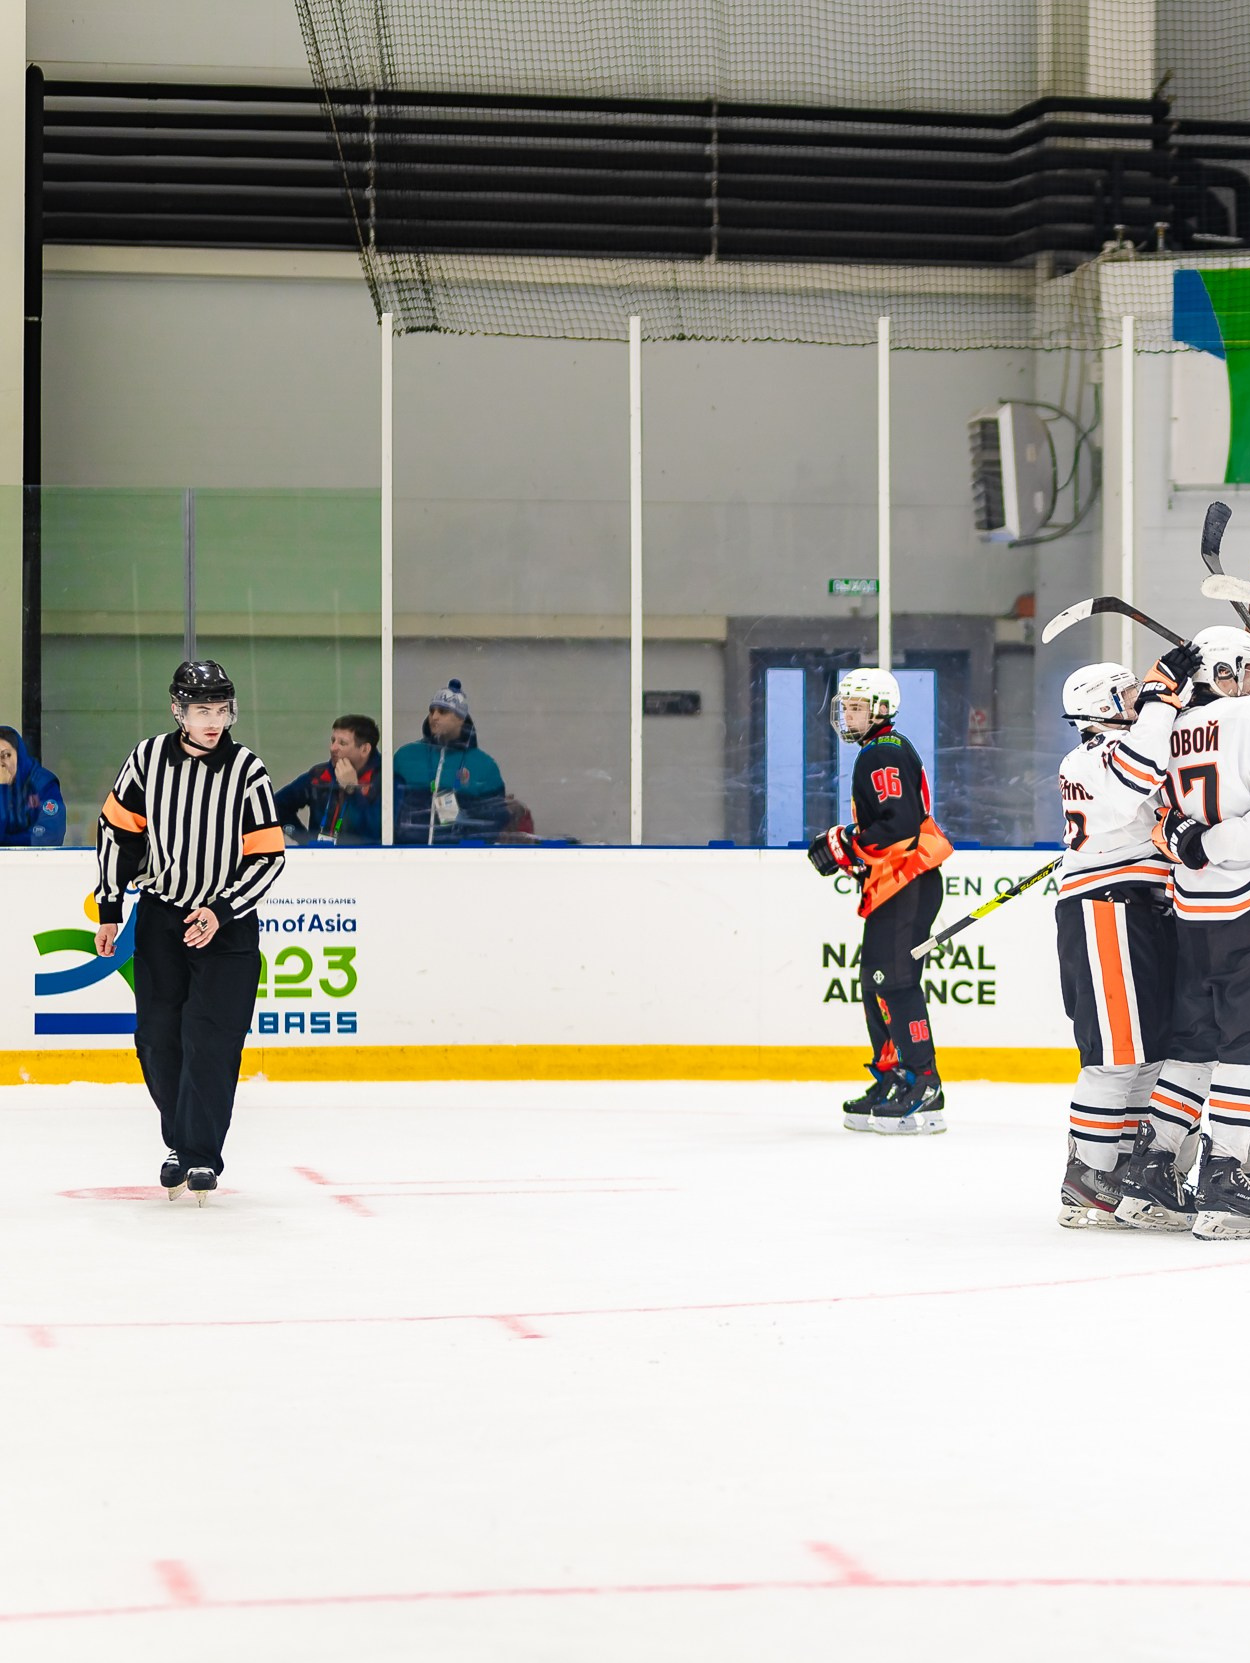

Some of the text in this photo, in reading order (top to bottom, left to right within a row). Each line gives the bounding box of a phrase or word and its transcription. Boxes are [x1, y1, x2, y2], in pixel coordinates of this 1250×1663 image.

[1171, 720, 1220, 758] ОВОЙ
[870, 766, 903, 803] 96
[282, 913, 306, 932] of
[308, 913, 357, 932] Asia
[256, 946, 358, 998] 23
[248, 1011, 358, 1034] BASS
[908, 1019, 930, 1043] 96
